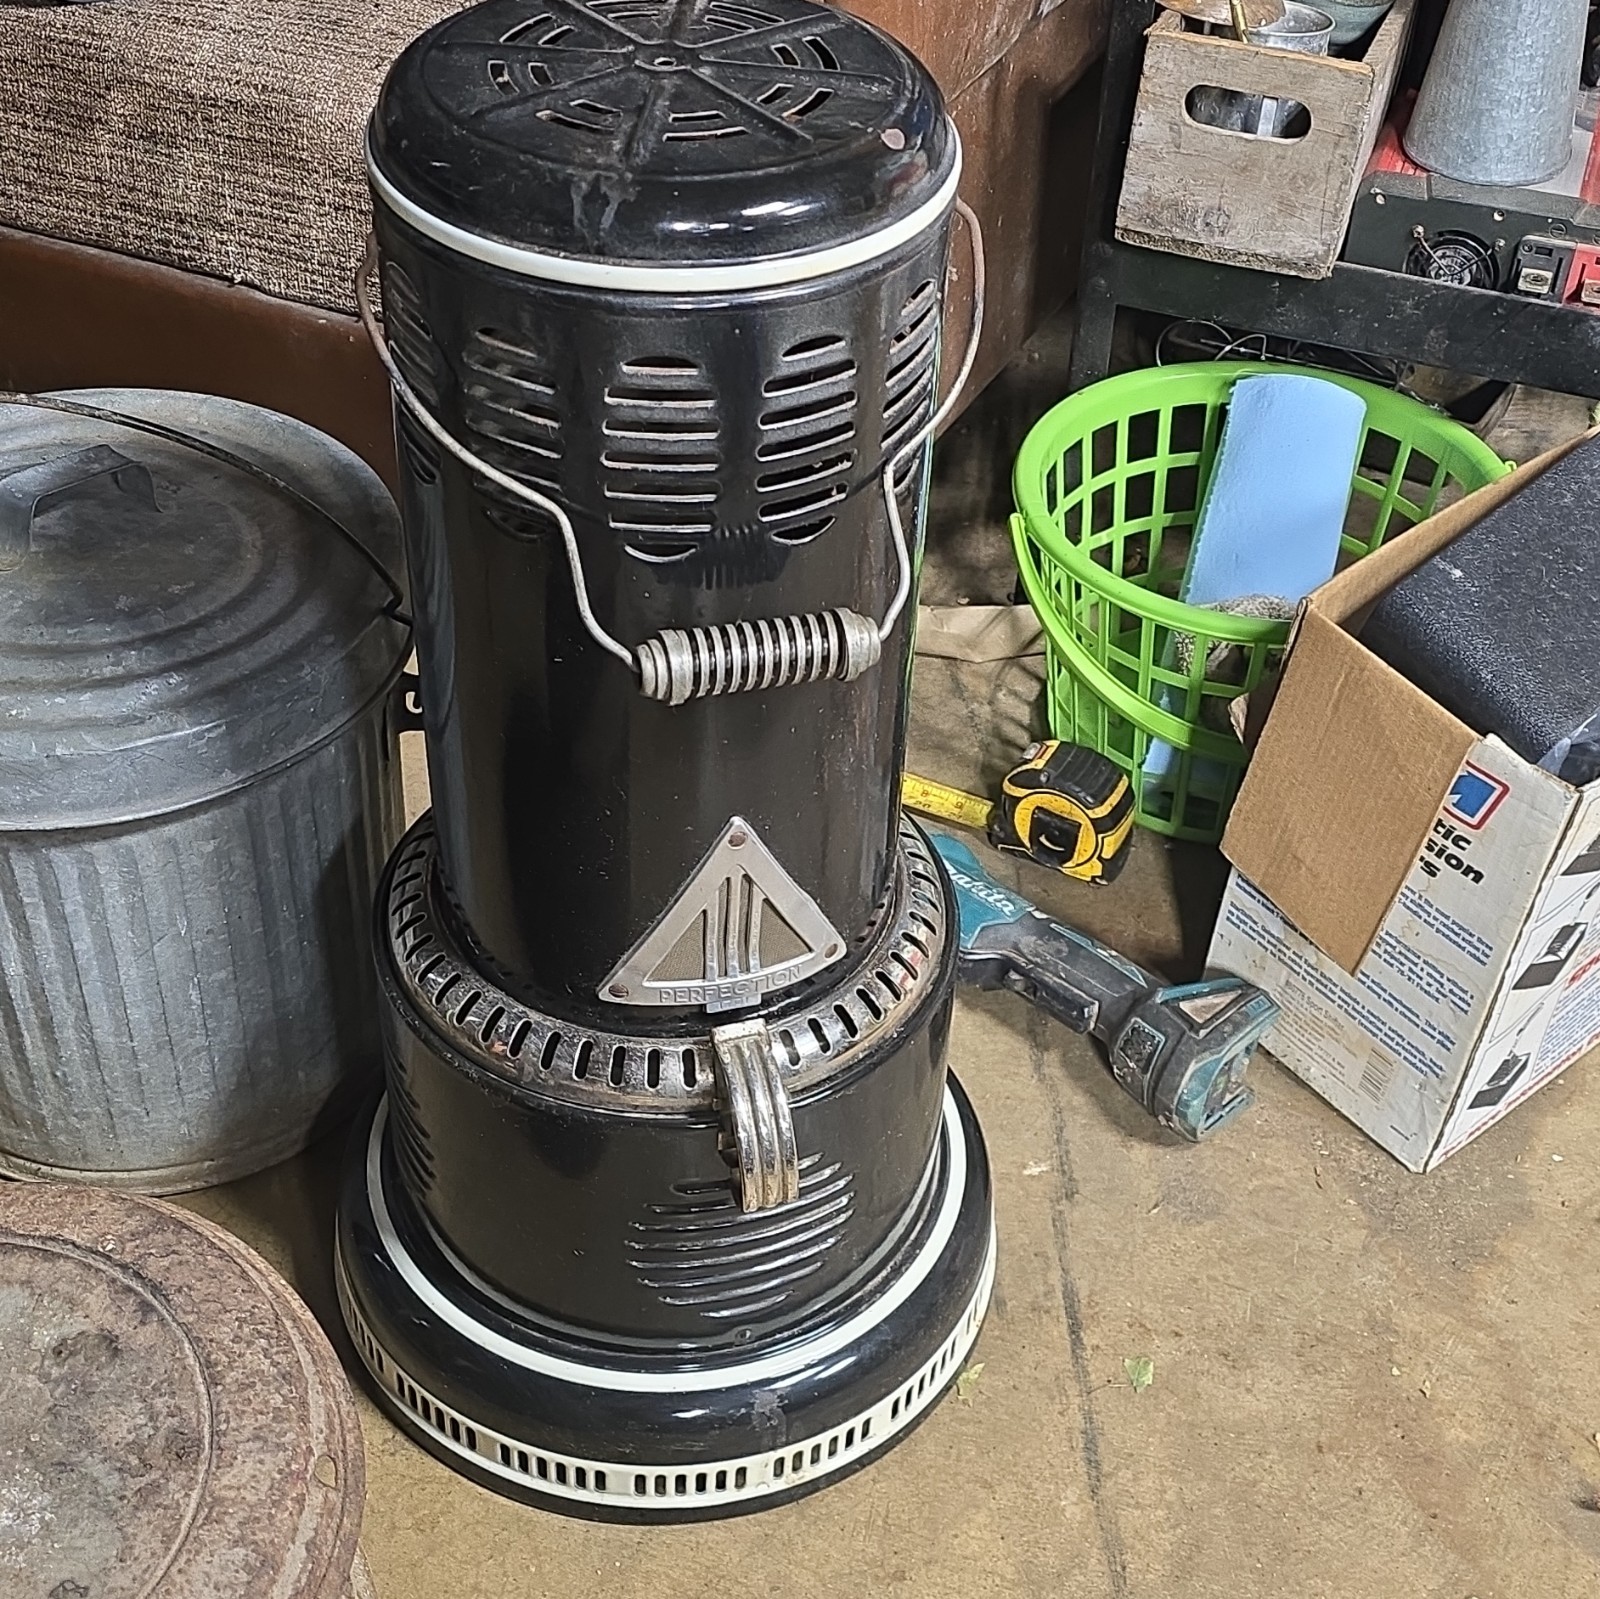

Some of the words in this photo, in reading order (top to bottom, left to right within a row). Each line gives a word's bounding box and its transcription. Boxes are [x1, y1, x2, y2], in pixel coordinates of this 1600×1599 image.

[1432, 817, 1473, 852] tic
[1418, 855, 1442, 878] s
[1424, 837, 1485, 885] sion
[1422, 916, 1435, 929] and
[1434, 925, 1466, 953] graduated
[1465, 948, 1488, 968] rubber
[1450, 917, 1476, 941] popular
[1475, 935, 1494, 952] three
[1460, 934, 1481, 953] action
[659, 964, 802, 1003] PERFECTION
[1266, 937, 1277, 949] and
[1382, 1030, 1395, 1043] and
[1291, 948, 1303, 961] and
[1387, 1023, 1407, 1044] safety
[1445, 974, 1469, 996] without
[1422, 1017, 1437, 1033] This
